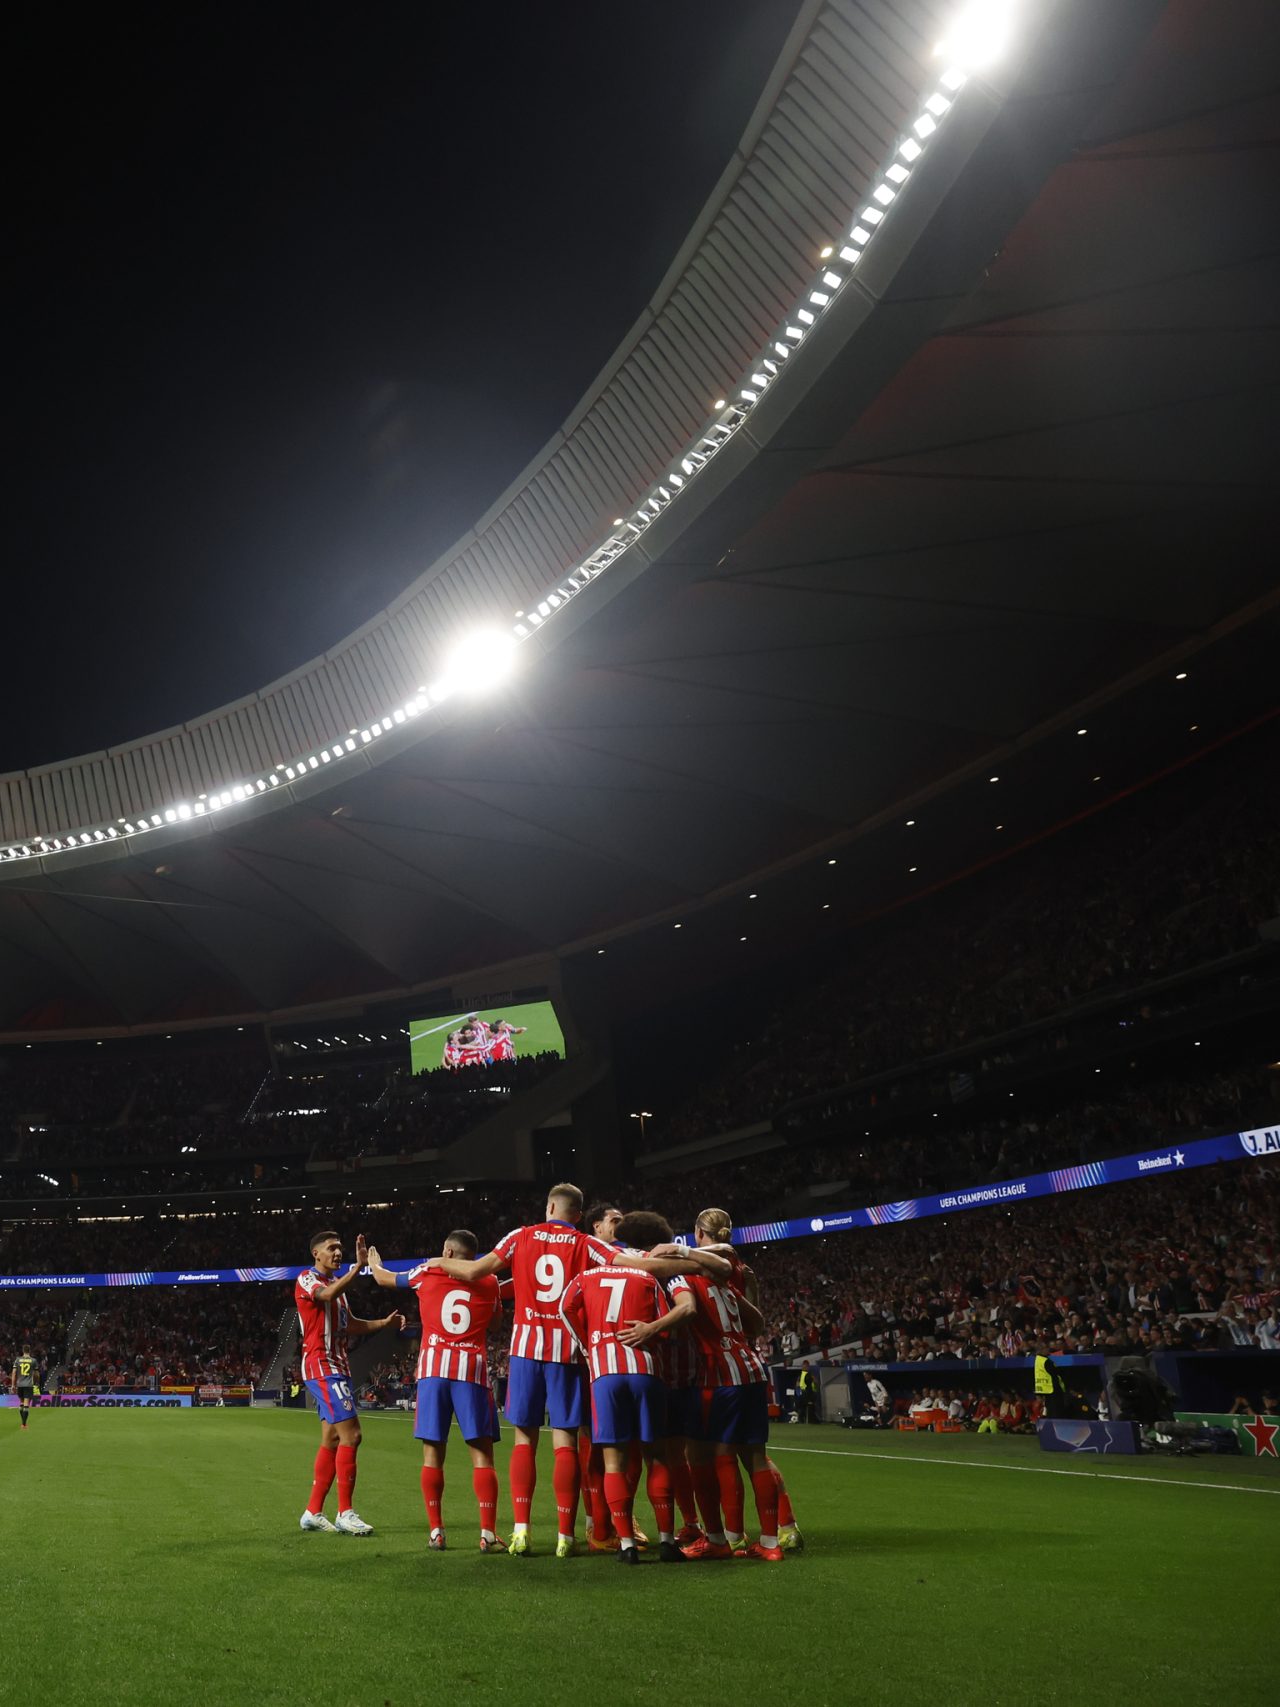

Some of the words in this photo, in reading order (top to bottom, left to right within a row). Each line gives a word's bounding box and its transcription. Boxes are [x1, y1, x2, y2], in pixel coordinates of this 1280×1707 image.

[1248, 1135, 1262, 1153] J.
[1137, 1155, 1172, 1171] Heineken
[939, 1197, 958, 1208] UEFA
[957, 1188, 998, 1205] CHAMPIONS
[998, 1183, 1027, 1198] LEAGUE
[824, 1216, 853, 1227] mastercard
[532, 1230, 576, 1245] SØRLOTH
[535, 1254, 565, 1303] 9
[583, 1266, 648, 1277] GRIEZMANN
[16, 1277, 58, 1285] CHAMPIONS
[599, 1278, 627, 1323] 7
[441, 1289, 472, 1335] 6
[707, 1285, 743, 1334] 19
[19, 1362, 31, 1376] 12
[331, 1380, 352, 1400] 16
[32, 1396, 180, 1408] FollowScores.com
